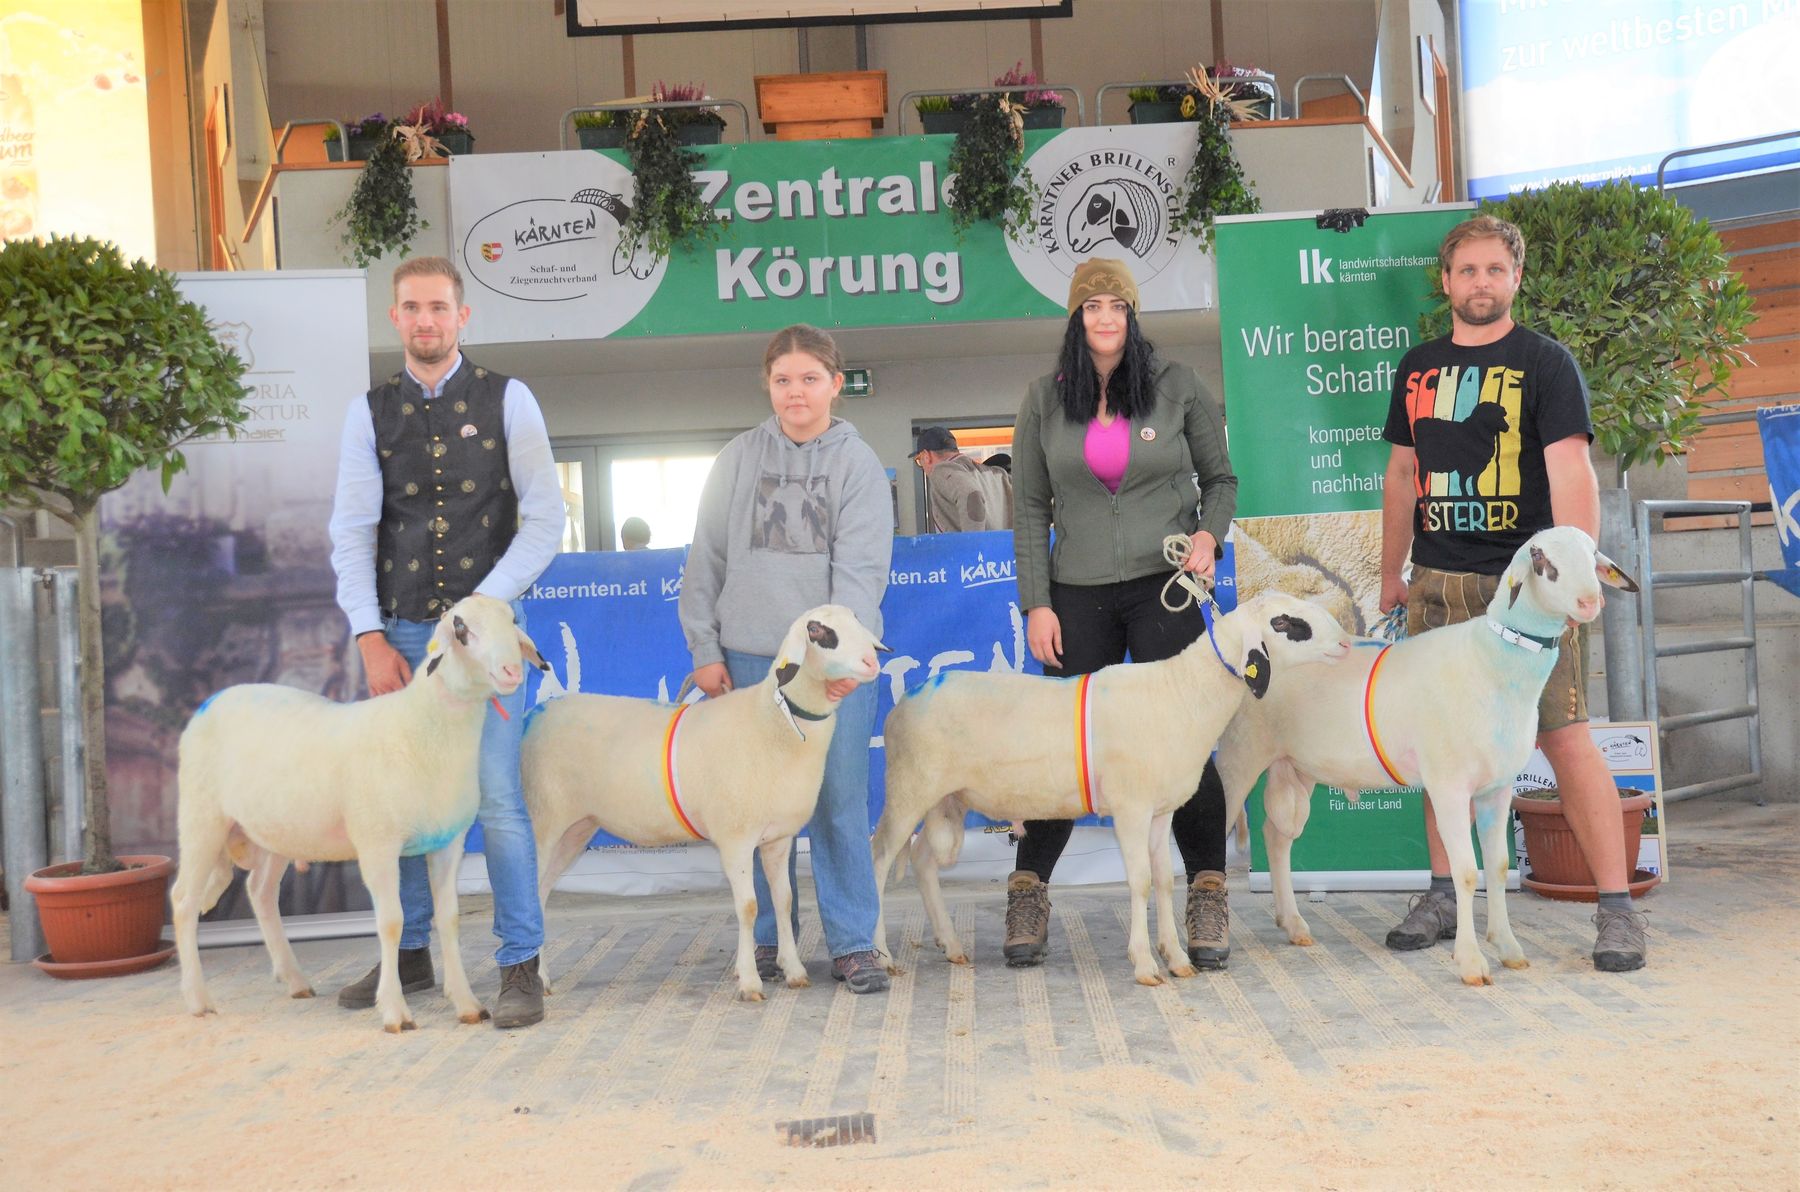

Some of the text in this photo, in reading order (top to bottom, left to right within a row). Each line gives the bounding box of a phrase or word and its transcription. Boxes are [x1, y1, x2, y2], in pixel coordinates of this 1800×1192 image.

[1501, 39, 1552, 72] zur
[1561, 2, 1748, 61] weltbesten
[1039, 161, 1084, 255] KÄRNTNER
[514, 209, 597, 246] KÄRNTEN
[510, 274, 597, 286] Ziegenzuchtverband
[530, 264, 577, 273] Schaf- und
[716, 246, 960, 303] Körung
[1339, 272, 1377, 283] kärnten
[1240, 322, 1410, 358] Wir beraten
[1309, 425, 1385, 447] kompete
[1405, 365, 1525, 498] SCHAFE
[1311, 449, 1342, 469] und
[1419, 501, 1518, 532] STERER
[1329, 798, 1402, 811] Für unser Land
